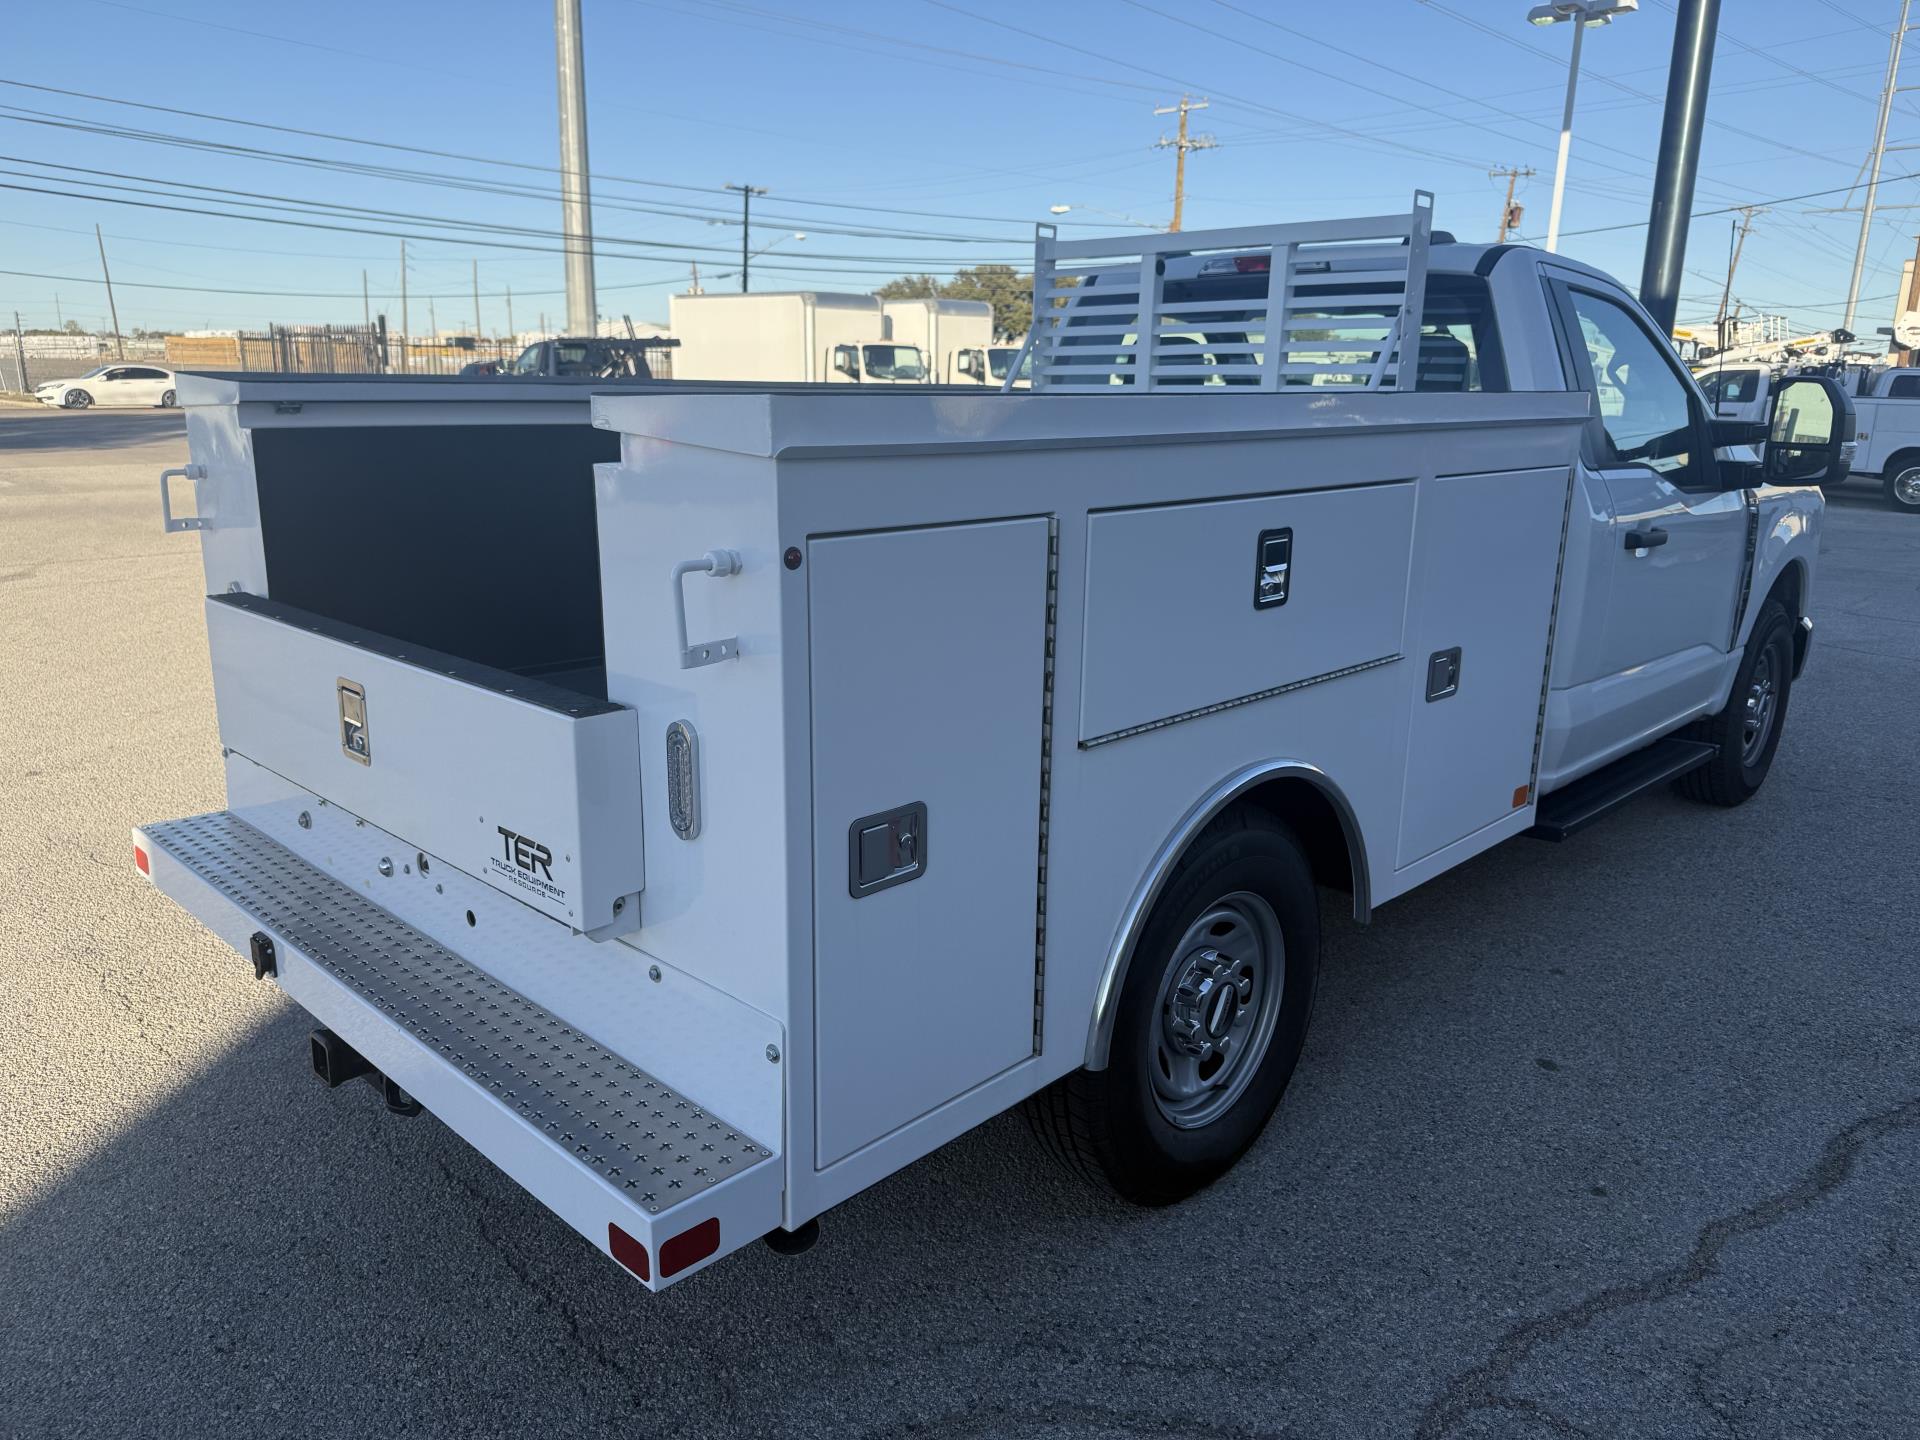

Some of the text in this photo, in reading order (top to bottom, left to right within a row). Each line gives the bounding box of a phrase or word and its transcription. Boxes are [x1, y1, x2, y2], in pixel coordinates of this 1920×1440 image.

[497, 825, 553, 882] TER
[490, 857, 565, 898] TRUCK EQUIPMENT
[508, 875, 546, 898] RESOURCE
